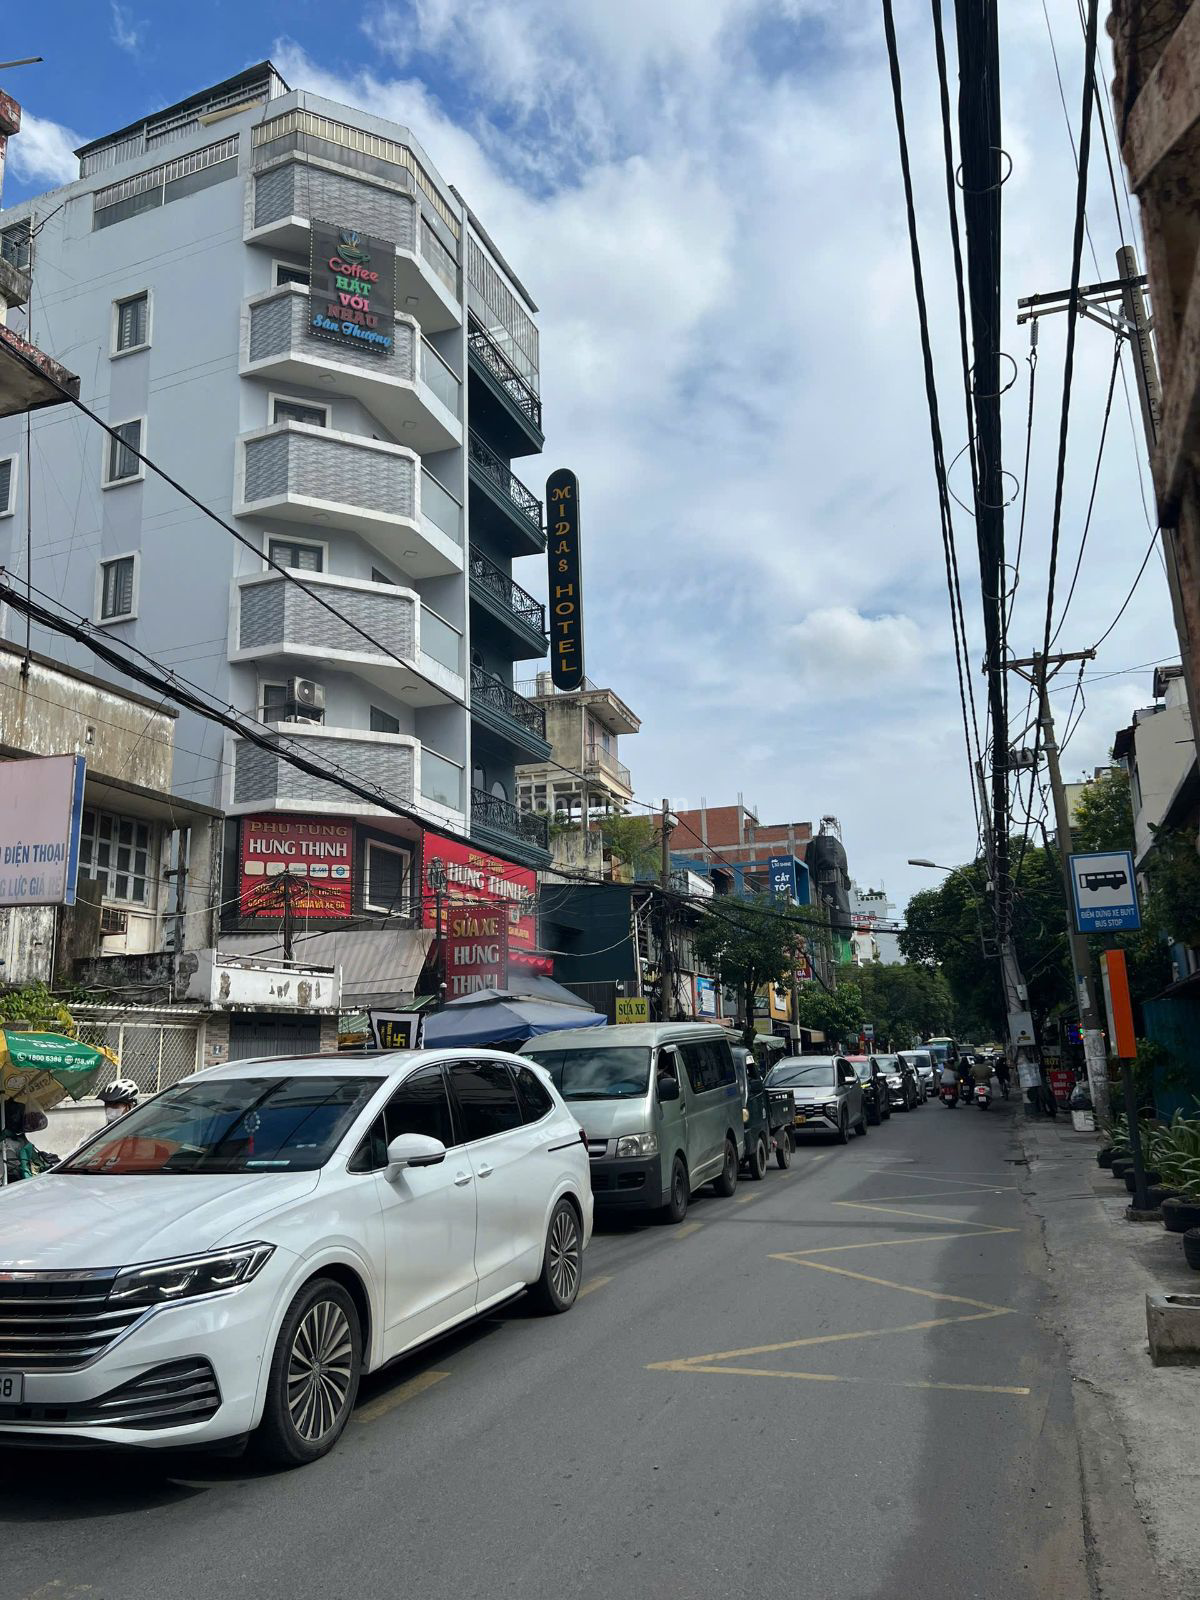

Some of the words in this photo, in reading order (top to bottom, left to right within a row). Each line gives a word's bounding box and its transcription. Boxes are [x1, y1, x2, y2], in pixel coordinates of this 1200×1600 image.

[329, 257, 378, 281] Coffee
[336, 275, 371, 295] HÁT
[339, 293, 370, 312] VỚI
[327, 304, 378, 328] NHAU
[551, 485, 571, 573] MIDAS
[555, 583, 577, 673] HOTEL
[250, 821, 290, 836] PHỤ
[295, 822, 348, 837] TÙNG
[4, 840, 30, 868] ĐIỆN
[32, 842, 65, 866] THOẠI
[249, 838, 296, 855] HƯNG
[299, 840, 347, 859] THỊNH
[1095, 919, 1108, 928] BUS
[1108, 918, 1123, 927] STOP
[1112, 909, 1121, 917] XE
[452, 912, 480, 938] SỬA
[480, 917, 500, 937] XE
[454, 943, 500, 966] HƯNG
[635, 1003, 646, 1015] XE
[0, 1377, 13, 1398] 8
